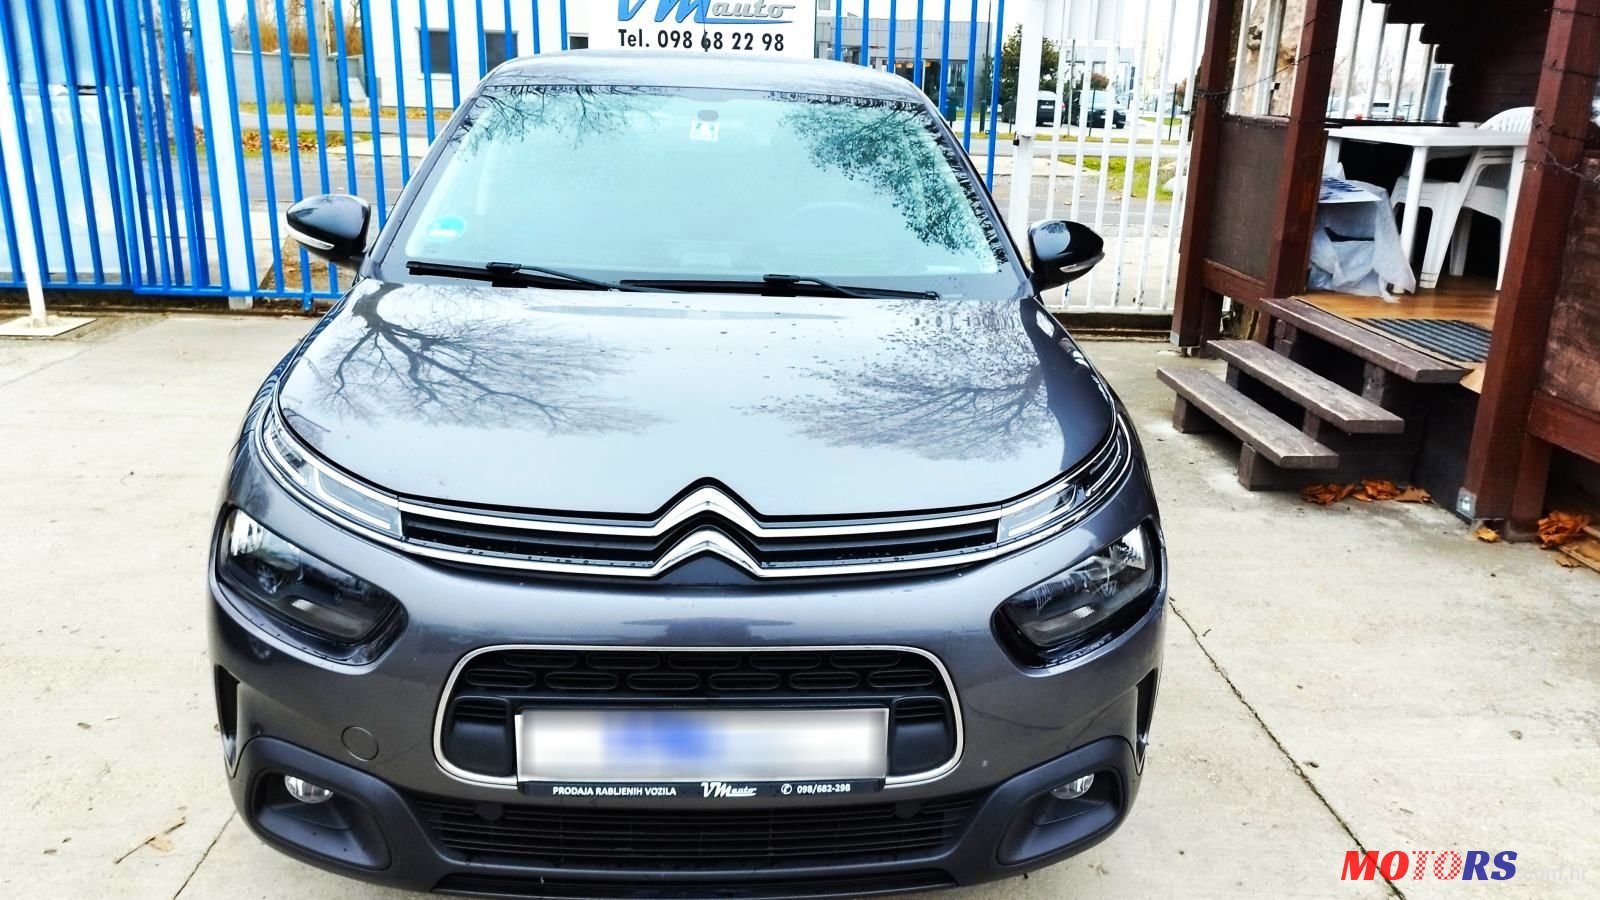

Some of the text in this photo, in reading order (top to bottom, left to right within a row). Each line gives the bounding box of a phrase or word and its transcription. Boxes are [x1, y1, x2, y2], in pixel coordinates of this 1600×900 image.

[711, 1, 796, 19] auto
[618, 28, 785, 51] Tel. 098 68 22 98
[552, 786, 594, 796] PRODAJA
[595, 786, 643, 797] RABLJENIH
[644, 786, 677, 796] VOZILA
[796, 783, 851, 795] 098/682-298
